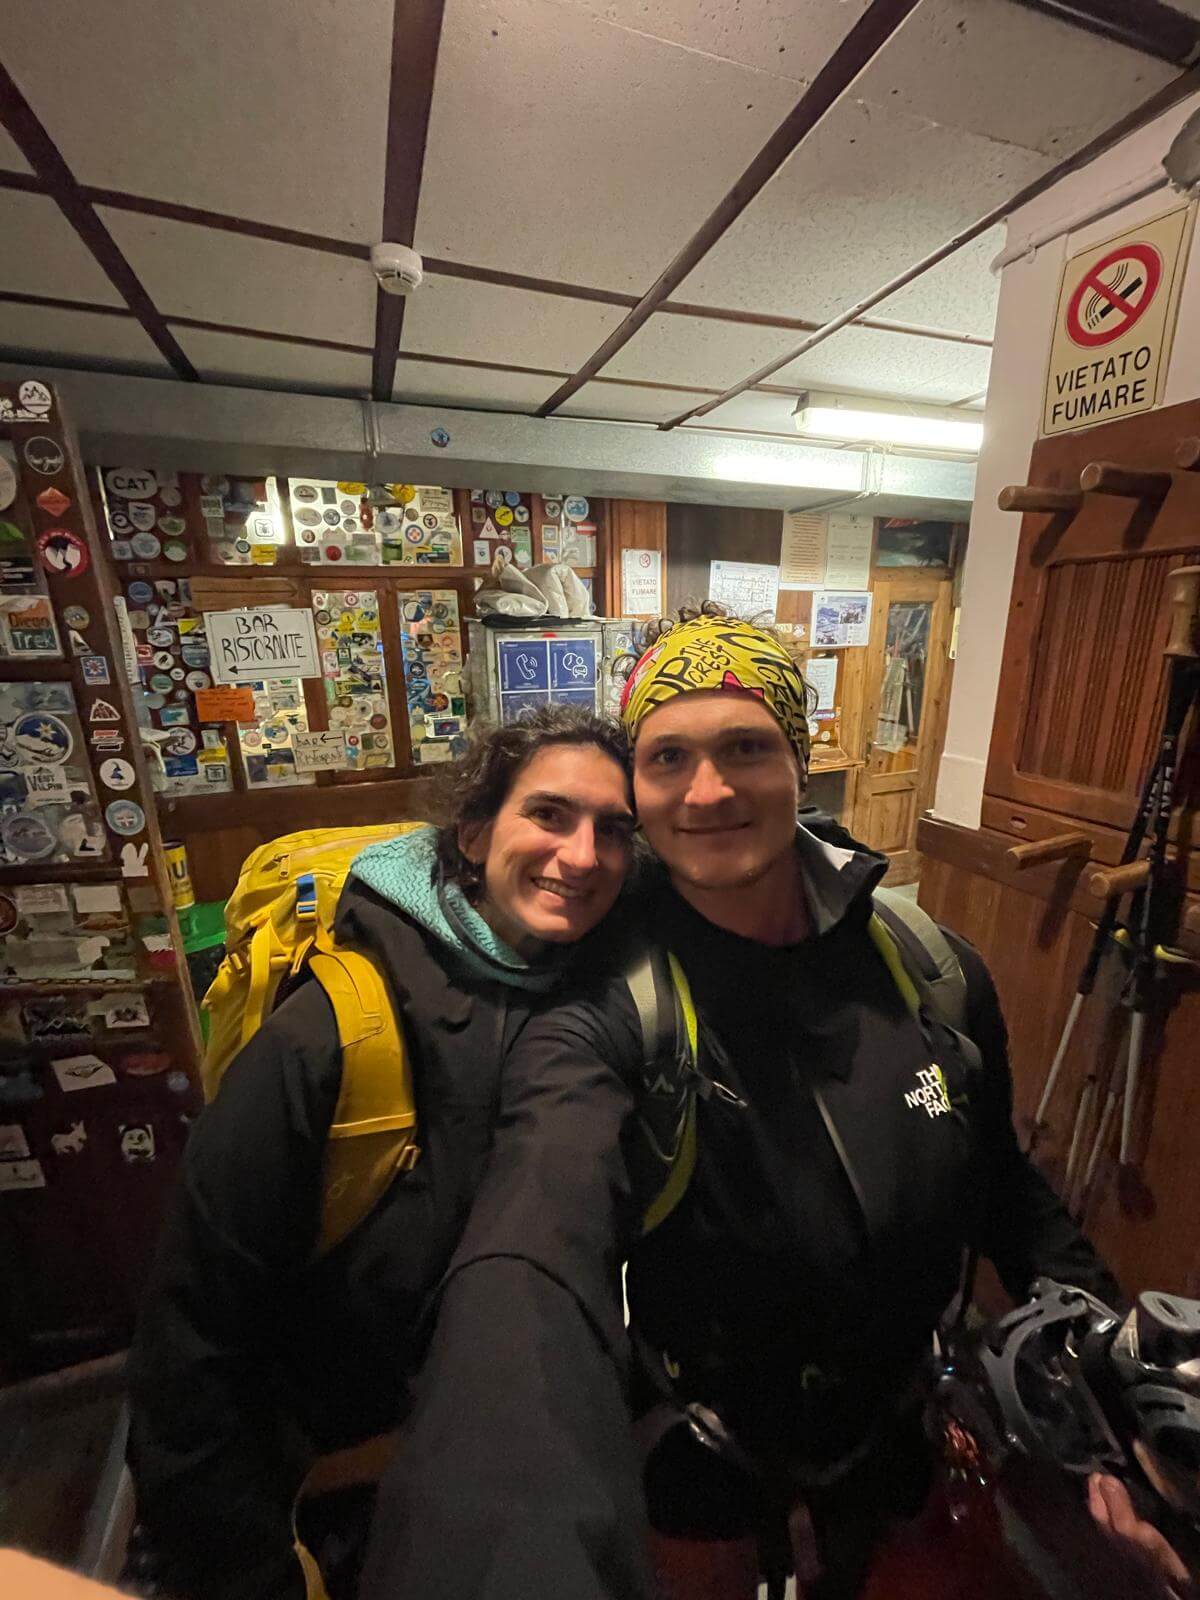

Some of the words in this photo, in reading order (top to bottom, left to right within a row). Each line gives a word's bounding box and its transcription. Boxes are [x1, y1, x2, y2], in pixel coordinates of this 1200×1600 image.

[1056, 346, 1151, 395] VIETATO
[1052, 379, 1147, 425] FUMARE
[113, 475, 150, 491] CAT
[632, 578, 657, 586] VIETATO
[632, 588, 657, 596] FUMARE
[236, 613, 279, 635] BAR
[221, 633, 307, 662] RISTORANTE
[680, 637, 716, 657] THE
[687, 645, 740, 684] CREST
[915, 1063, 942, 1087] TH
[904, 1080, 946, 1109] NORT
